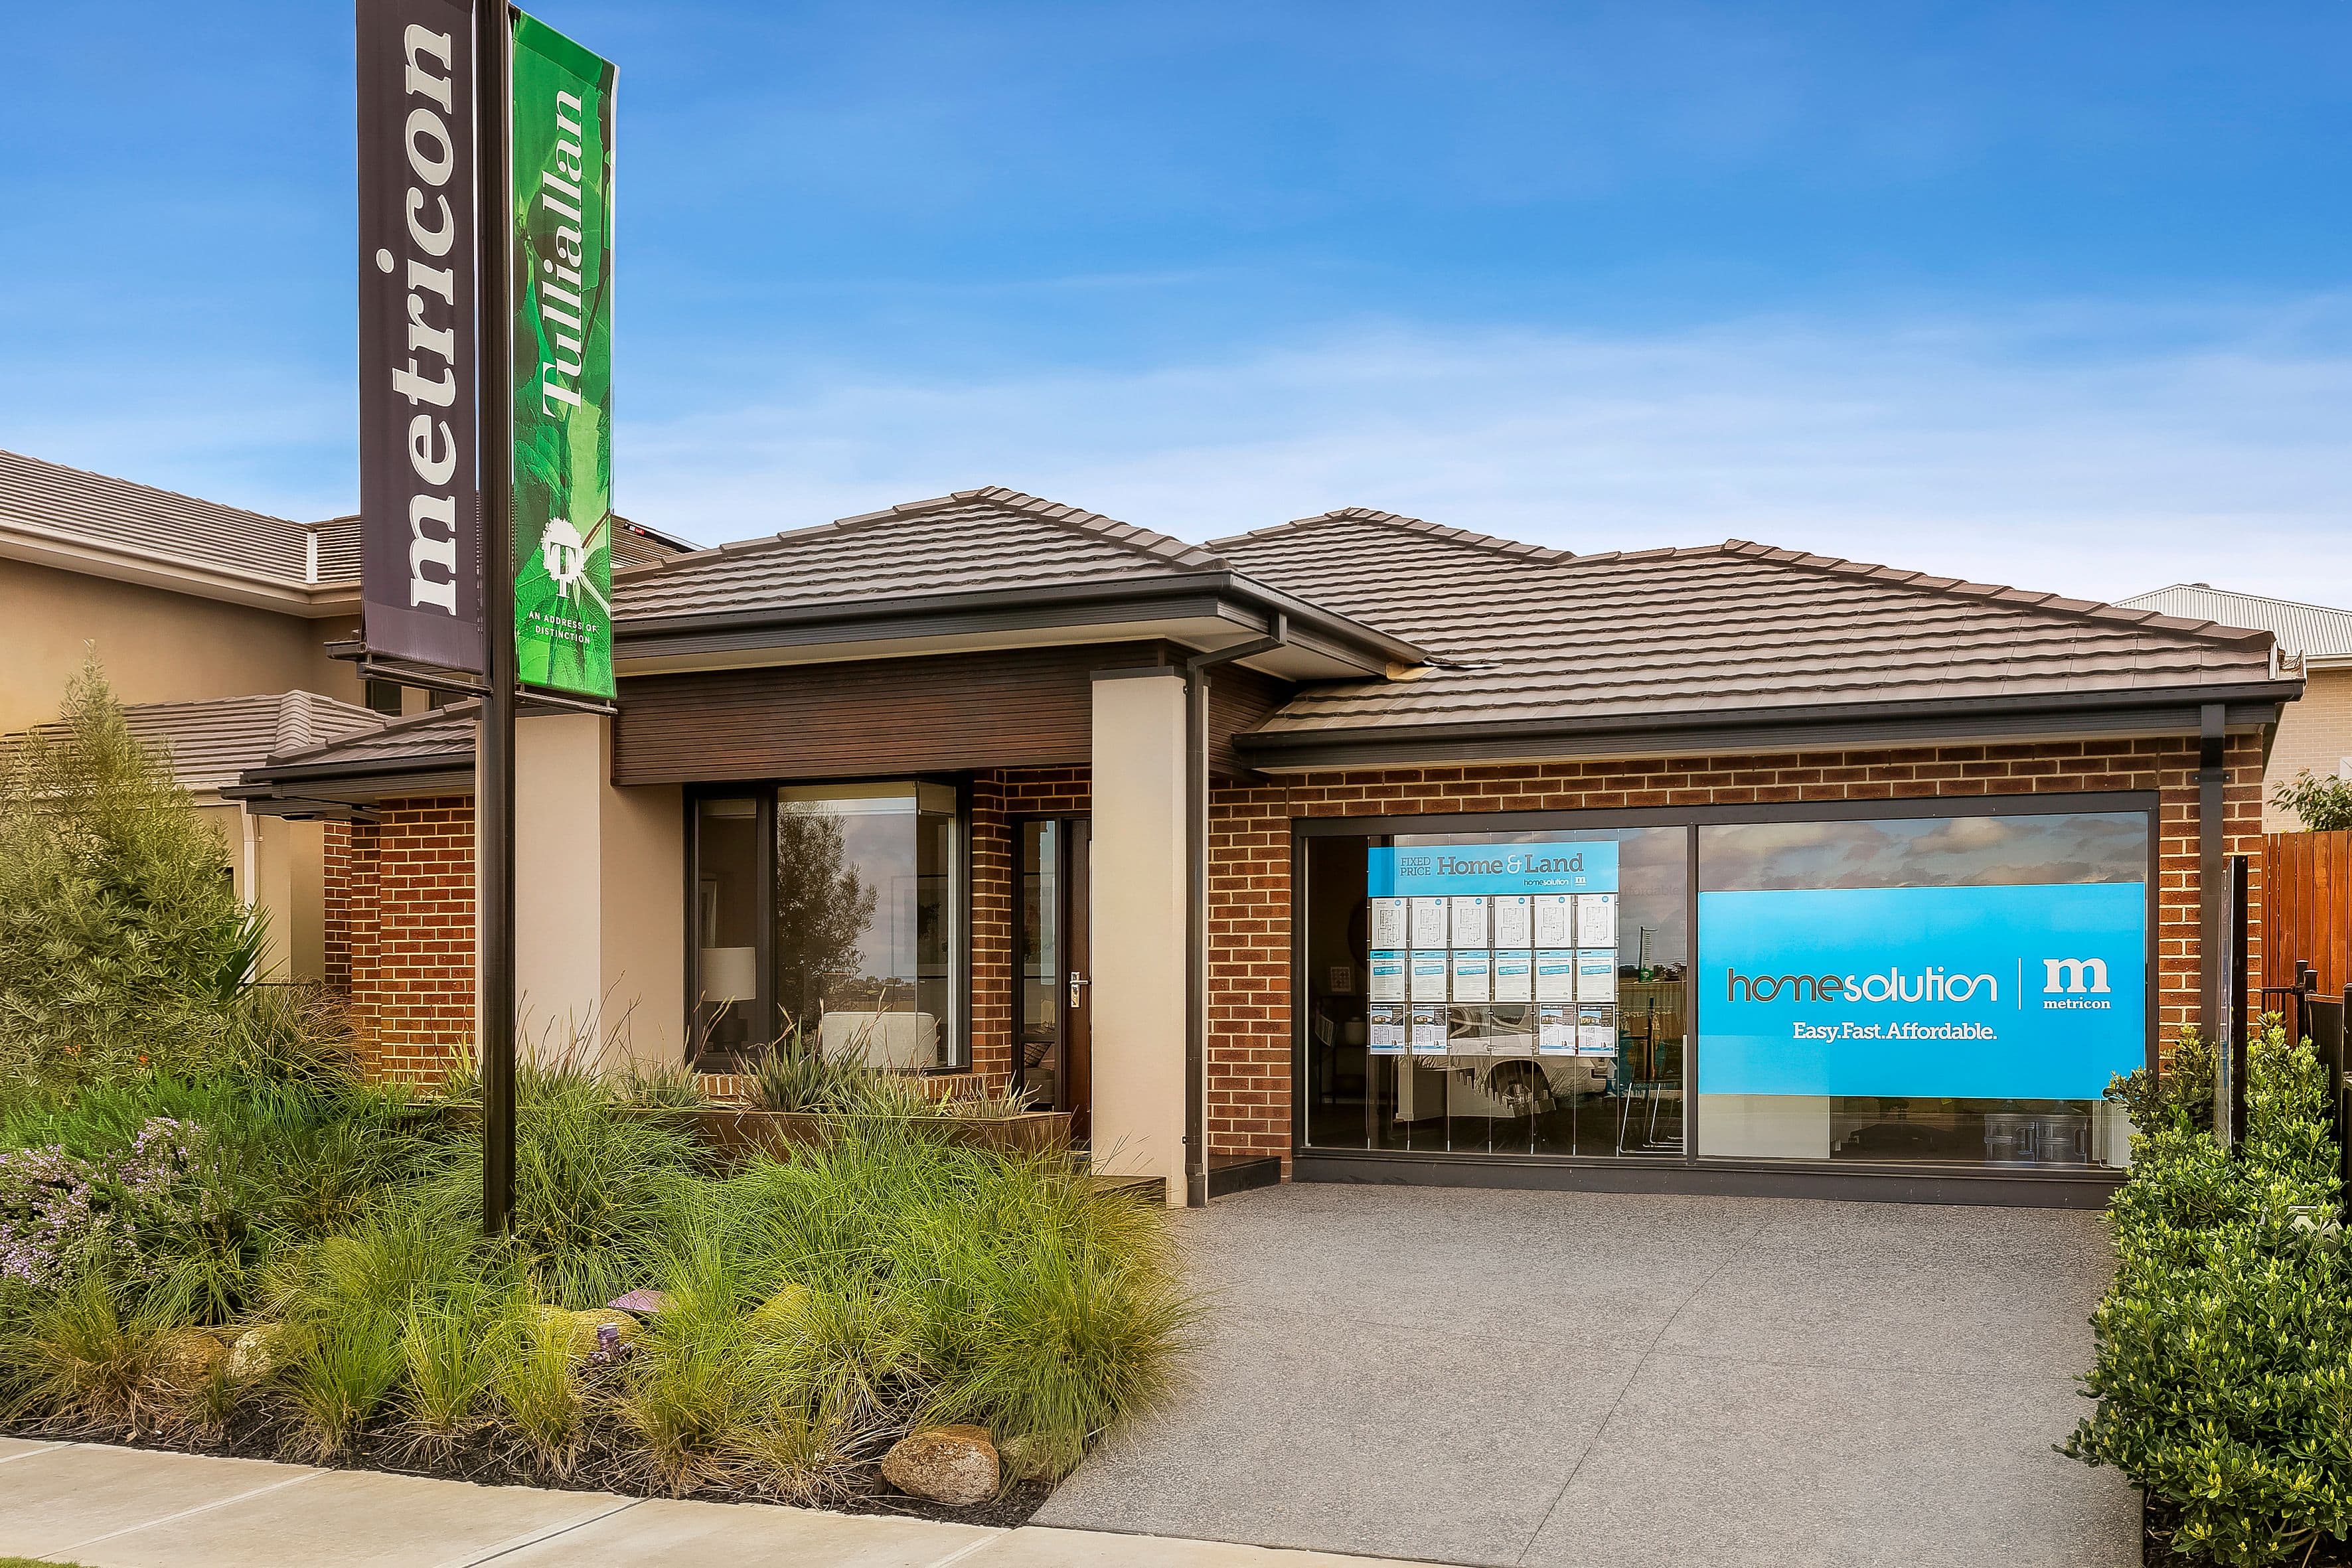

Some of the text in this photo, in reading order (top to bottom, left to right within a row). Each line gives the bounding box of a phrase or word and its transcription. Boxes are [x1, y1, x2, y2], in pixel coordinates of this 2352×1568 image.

[540, 90, 582, 418] Tulliallan
[376, 23, 457, 616] metricon
[529, 611, 597, 633] AN ADDRESS OF
[535, 625, 590, 644] DISTINCTION
[1400, 866, 1431, 876] PRICE
[1401, 856, 1431, 866] FIXED
[1437, 853, 1585, 875] Home & Land
[1727, 966, 1998, 1002] homesolution
[2043, 957, 2112, 994] m
[2043, 995, 2112, 1010] metricon
